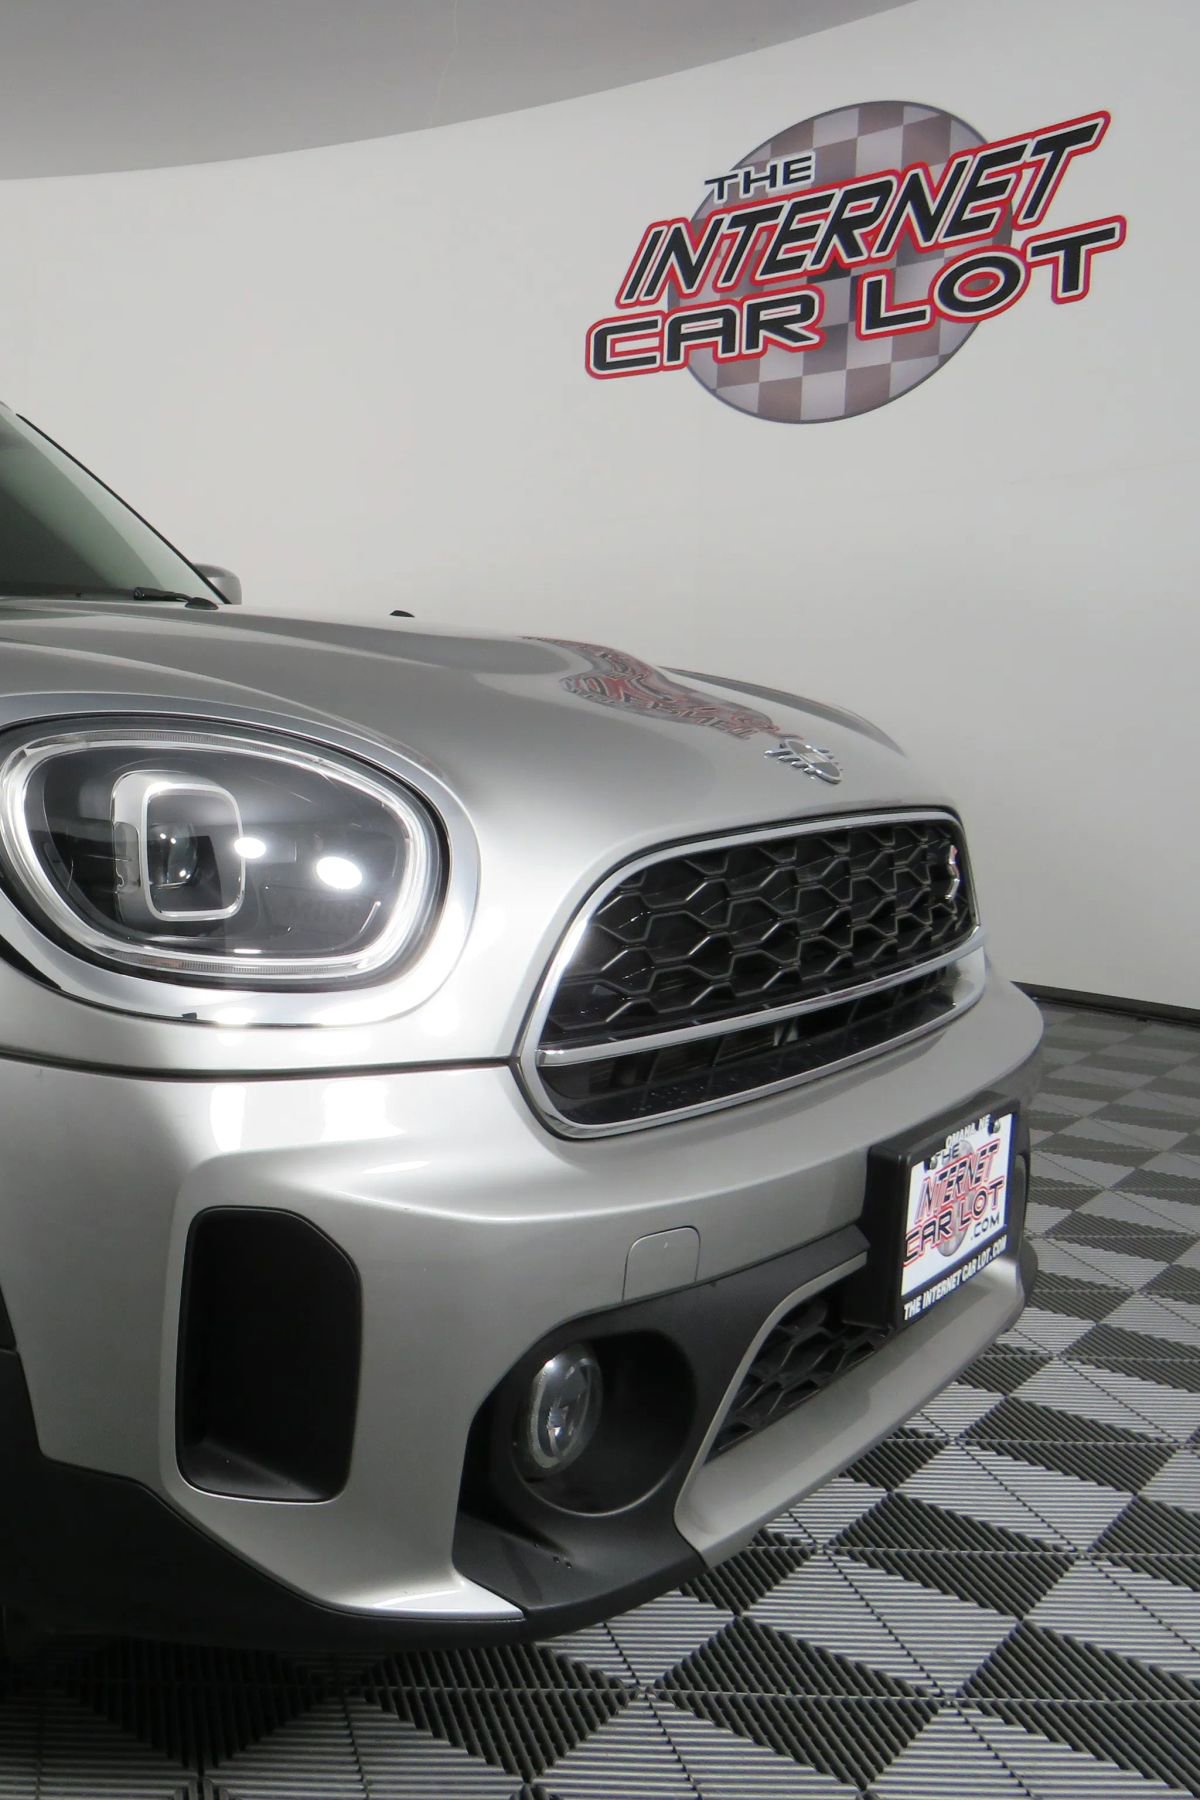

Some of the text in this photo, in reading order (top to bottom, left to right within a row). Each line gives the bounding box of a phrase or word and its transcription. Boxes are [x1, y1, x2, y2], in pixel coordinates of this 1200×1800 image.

[616, 111, 1110, 308] INTERNET
[704, 152, 815, 204] THE
[587, 216, 1125, 377] CAR LOT
[916, 1139, 1000, 1222] INTERNET
[933, 1142, 960, 1165] THE
[904, 1177, 1004, 1267] CAR LOT
[903, 1298, 921, 1321] THE
[922, 1268, 961, 1309] INTERNET
[961, 1258, 977, 1282] CAR
